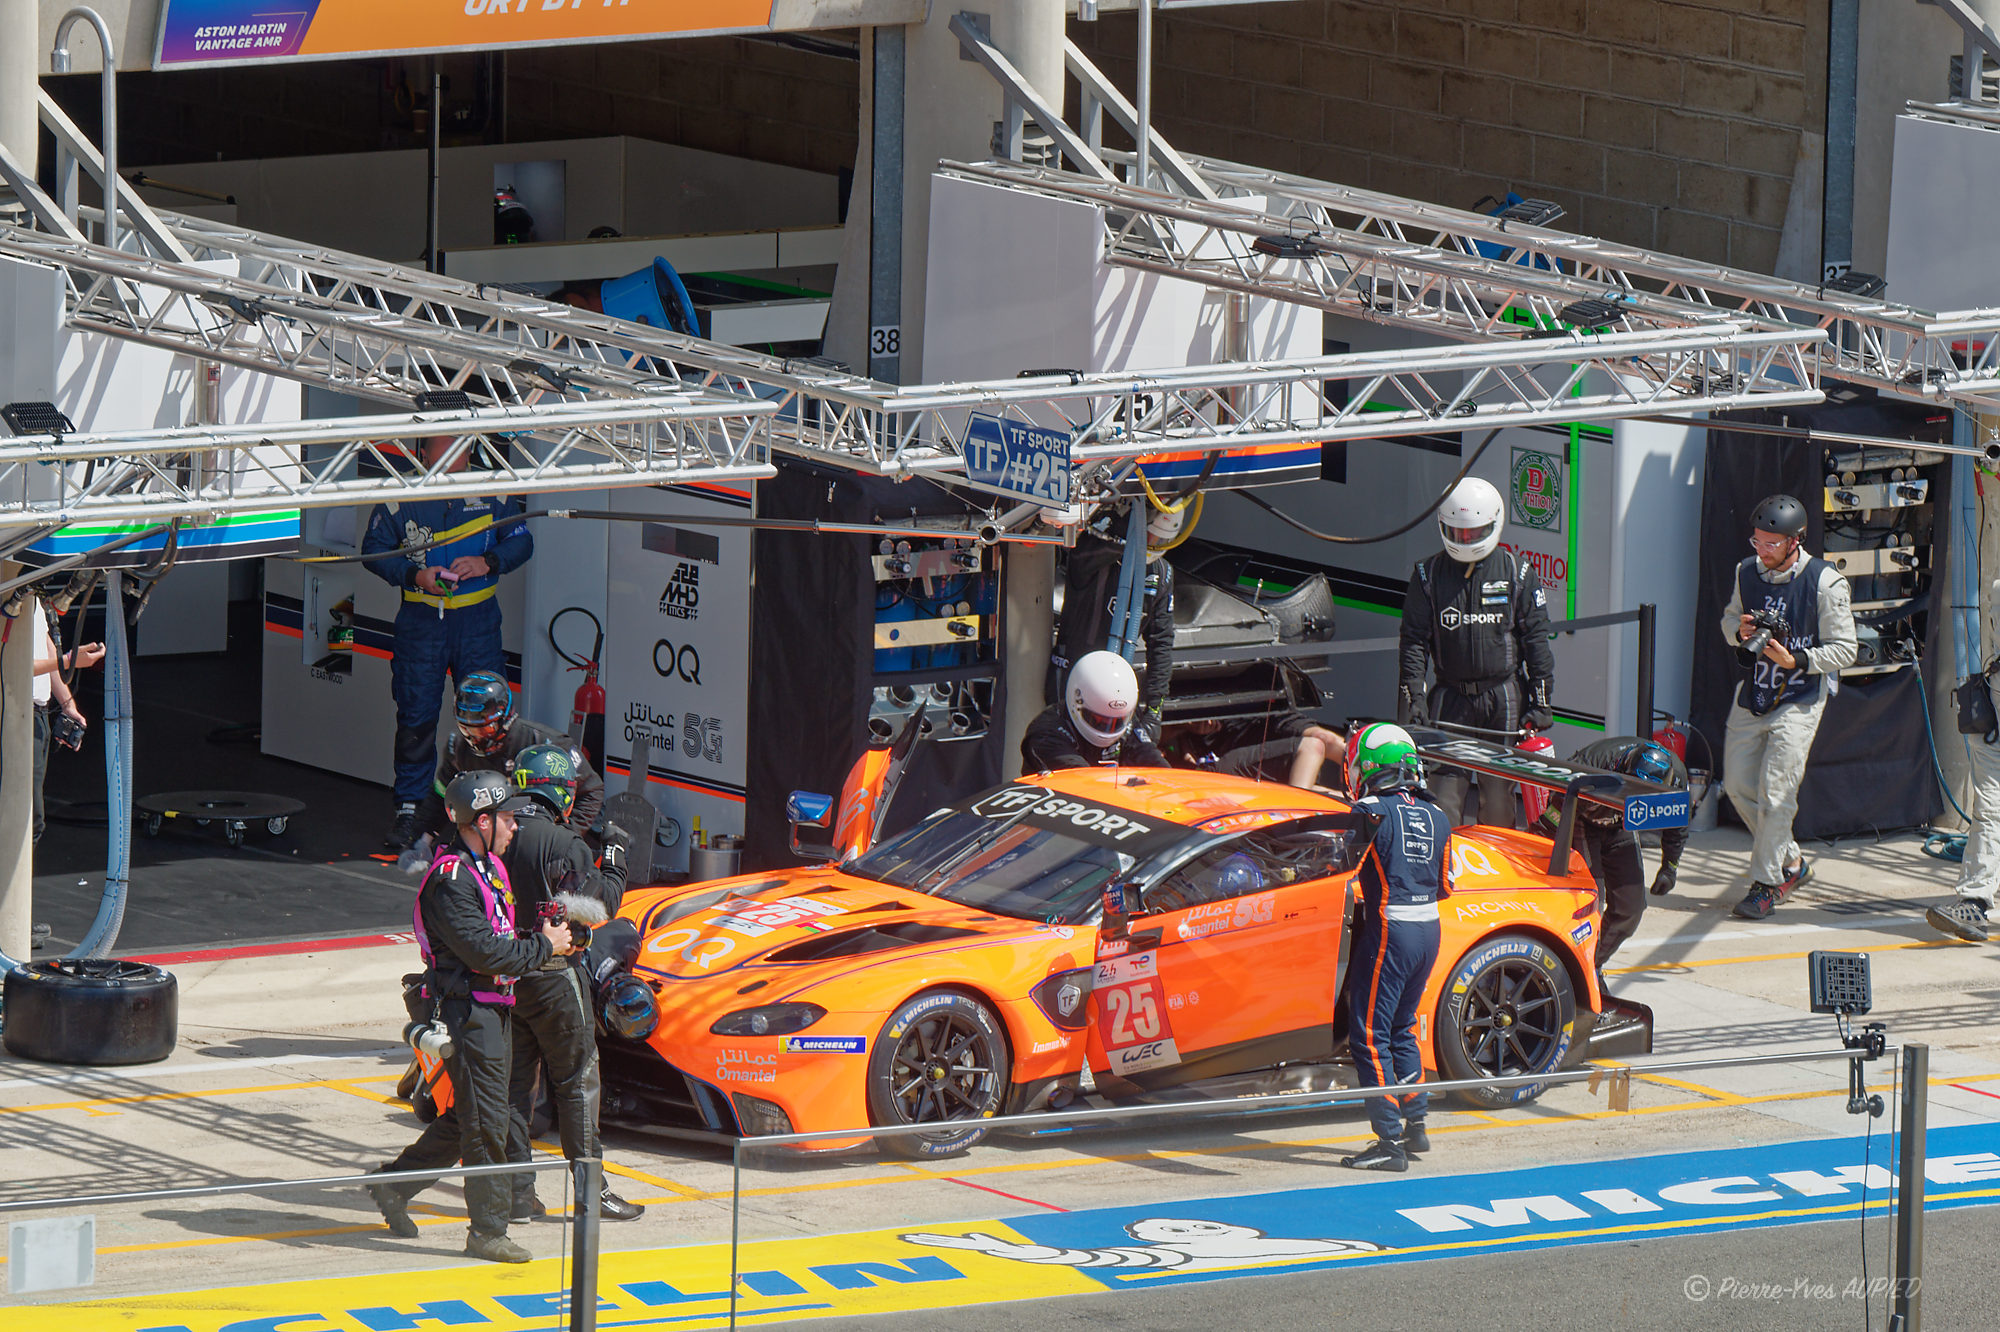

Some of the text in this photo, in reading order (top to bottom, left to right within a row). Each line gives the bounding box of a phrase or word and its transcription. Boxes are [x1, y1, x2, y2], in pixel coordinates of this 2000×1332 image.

[194, 22, 287, 38] ASTON MARTIN
[195, 36, 282, 51] VANTAGE AMR
[872, 328, 899, 354] 38
[1010, 427, 1068, 456] TF SPORT
[969, 437, 1002, 472] TF
[1010, 451, 1067, 502] #25
[1444, 613, 1503, 624] TF SPORT
[653, 639, 701, 686] OQ
[624, 702, 674, 728] عمانتل
[683, 712, 723, 764] 5G
[990, 791, 1151, 841] TF SPORT
[1631, 805, 1644, 819] TF
[736, 904, 813, 925] 25
[1233, 893, 1276, 927] 5G
[1455, 901, 1545, 922] ARCHIVE
[1177, 917, 1230, 938] Omantel
[647, 928, 736, 969] OQ
[1471, 943, 1529, 975] MICHELIN
[905, 997, 953, 1022] MICHELIN
[1062, 994, 1077, 1008] TF
[1107, 982, 1160, 1045] 25
[716, 1049, 777, 1066] عمانتل
[803, 1041, 857, 1050] MICHELIN
[1122, 1043, 1163, 1064] WEC
[716, 1067, 776, 1083] Omantel
[933, 1129, 980, 1152] MICHELIN
